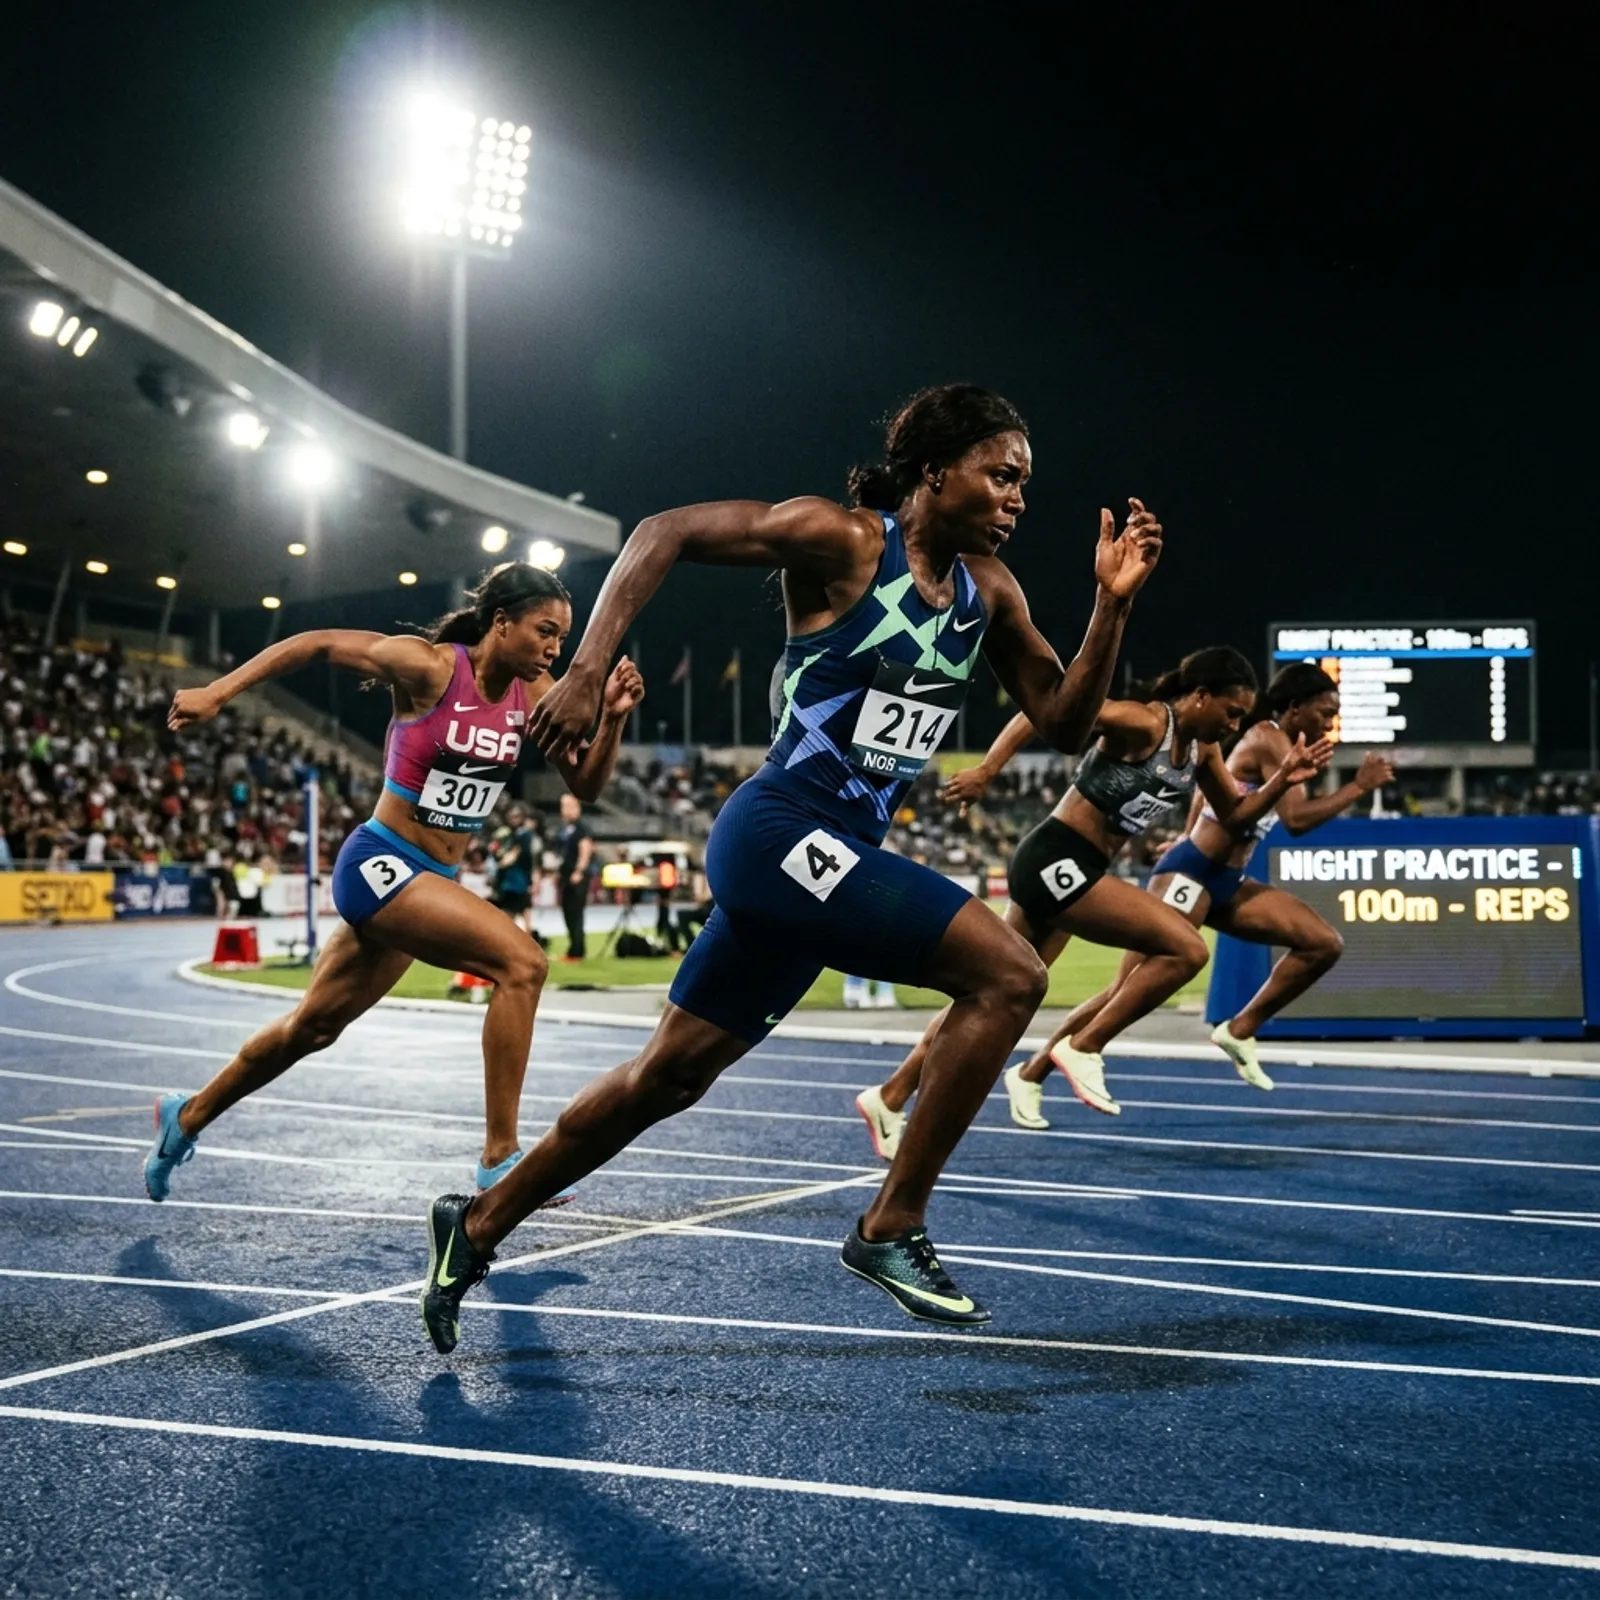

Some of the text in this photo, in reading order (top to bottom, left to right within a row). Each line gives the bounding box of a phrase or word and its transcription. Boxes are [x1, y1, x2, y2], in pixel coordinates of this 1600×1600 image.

[446, 720, 522, 762] USA
[873, 702, 944, 751] 214
[436, 778, 491, 813] 301
[372, 860, 397, 886] 3
[806, 842, 841, 881] 4
[1054, 865, 1074, 890] 6
[1279, 850, 1378, 881] NIGHT
[1384, 848, 1540, 880] PRACTICE
[1547, 861, 1563, 871] -
[1173, 885, 1190, 904] 6
[1338, 888, 1570, 922] 100m - REPS
